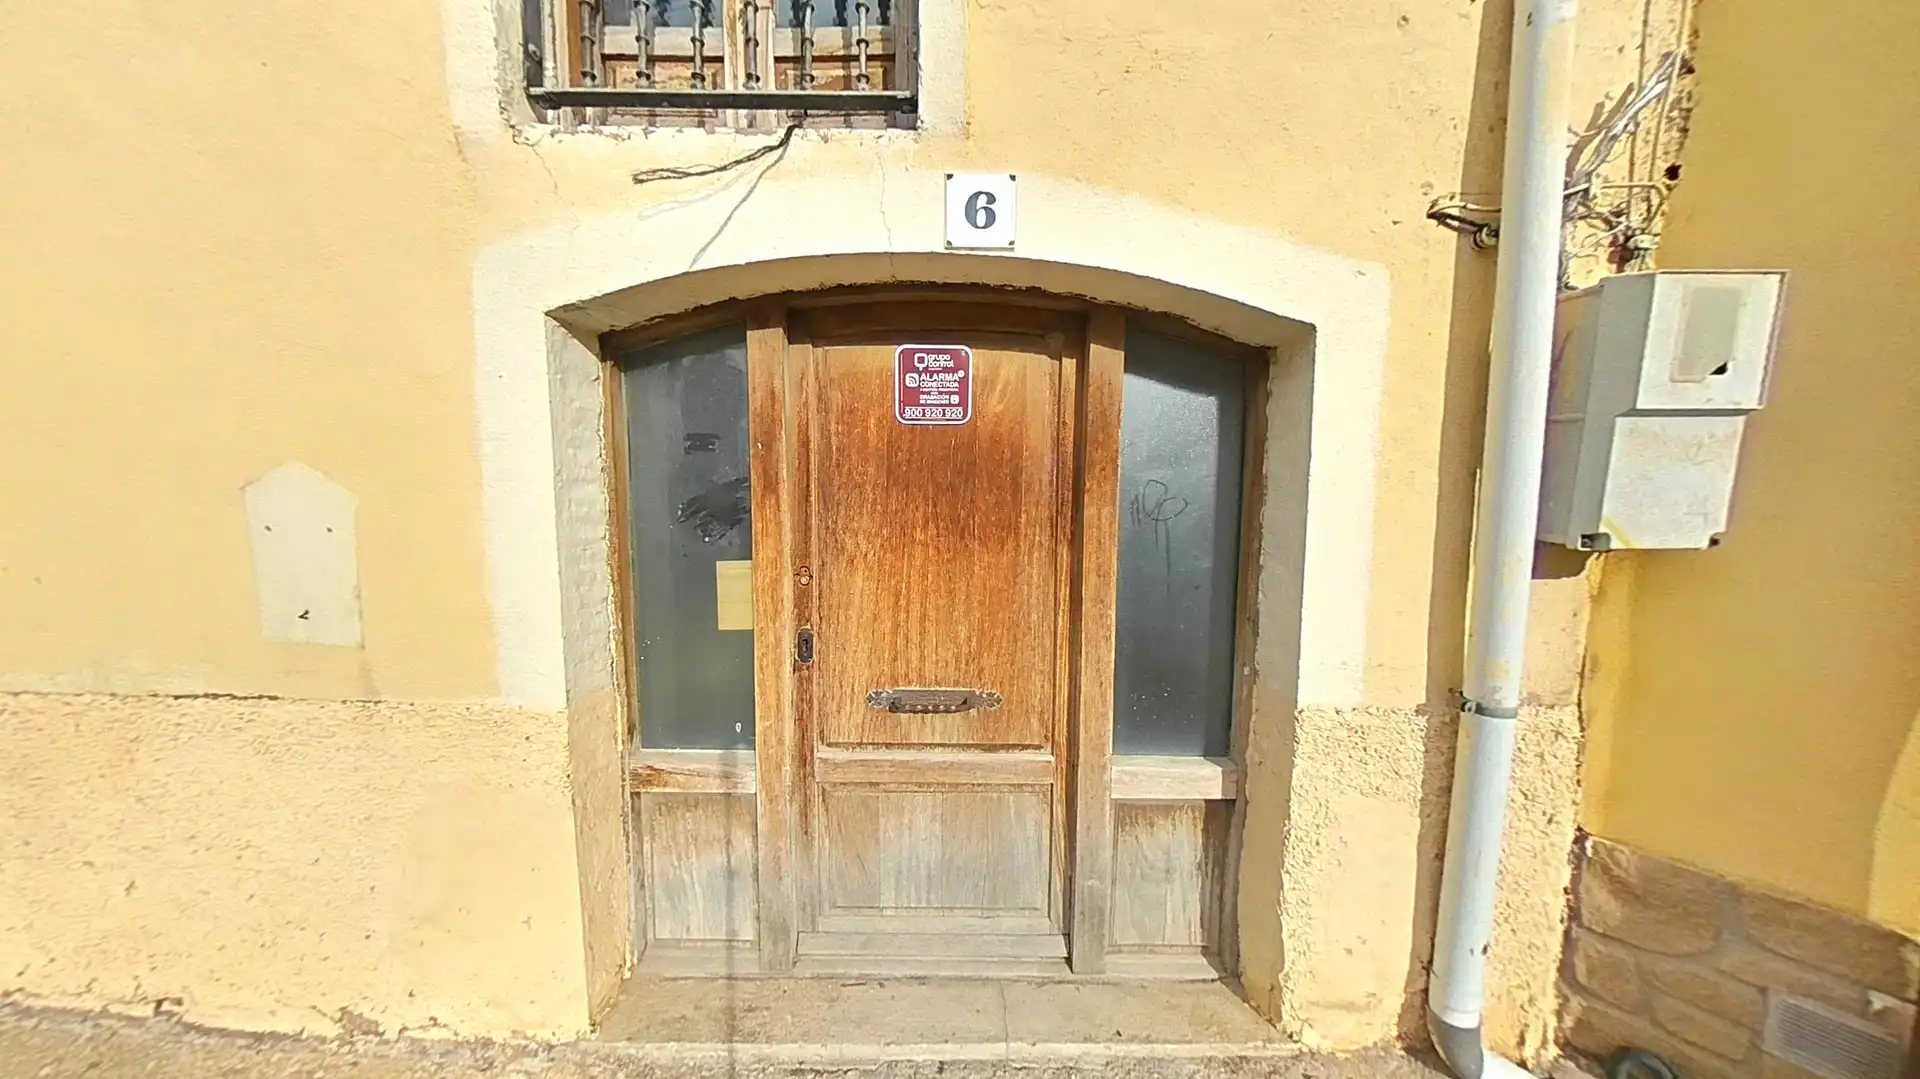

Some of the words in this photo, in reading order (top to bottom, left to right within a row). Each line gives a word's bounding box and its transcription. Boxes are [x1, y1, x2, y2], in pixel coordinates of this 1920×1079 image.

[964, 190, 997, 230] 6
[928, 360, 954, 368] control
[920, 372, 960, 382] ALARMA
[904, 408, 923, 417] 900
[925, 408, 943, 417] 920
[945, 408, 963, 417] 920
